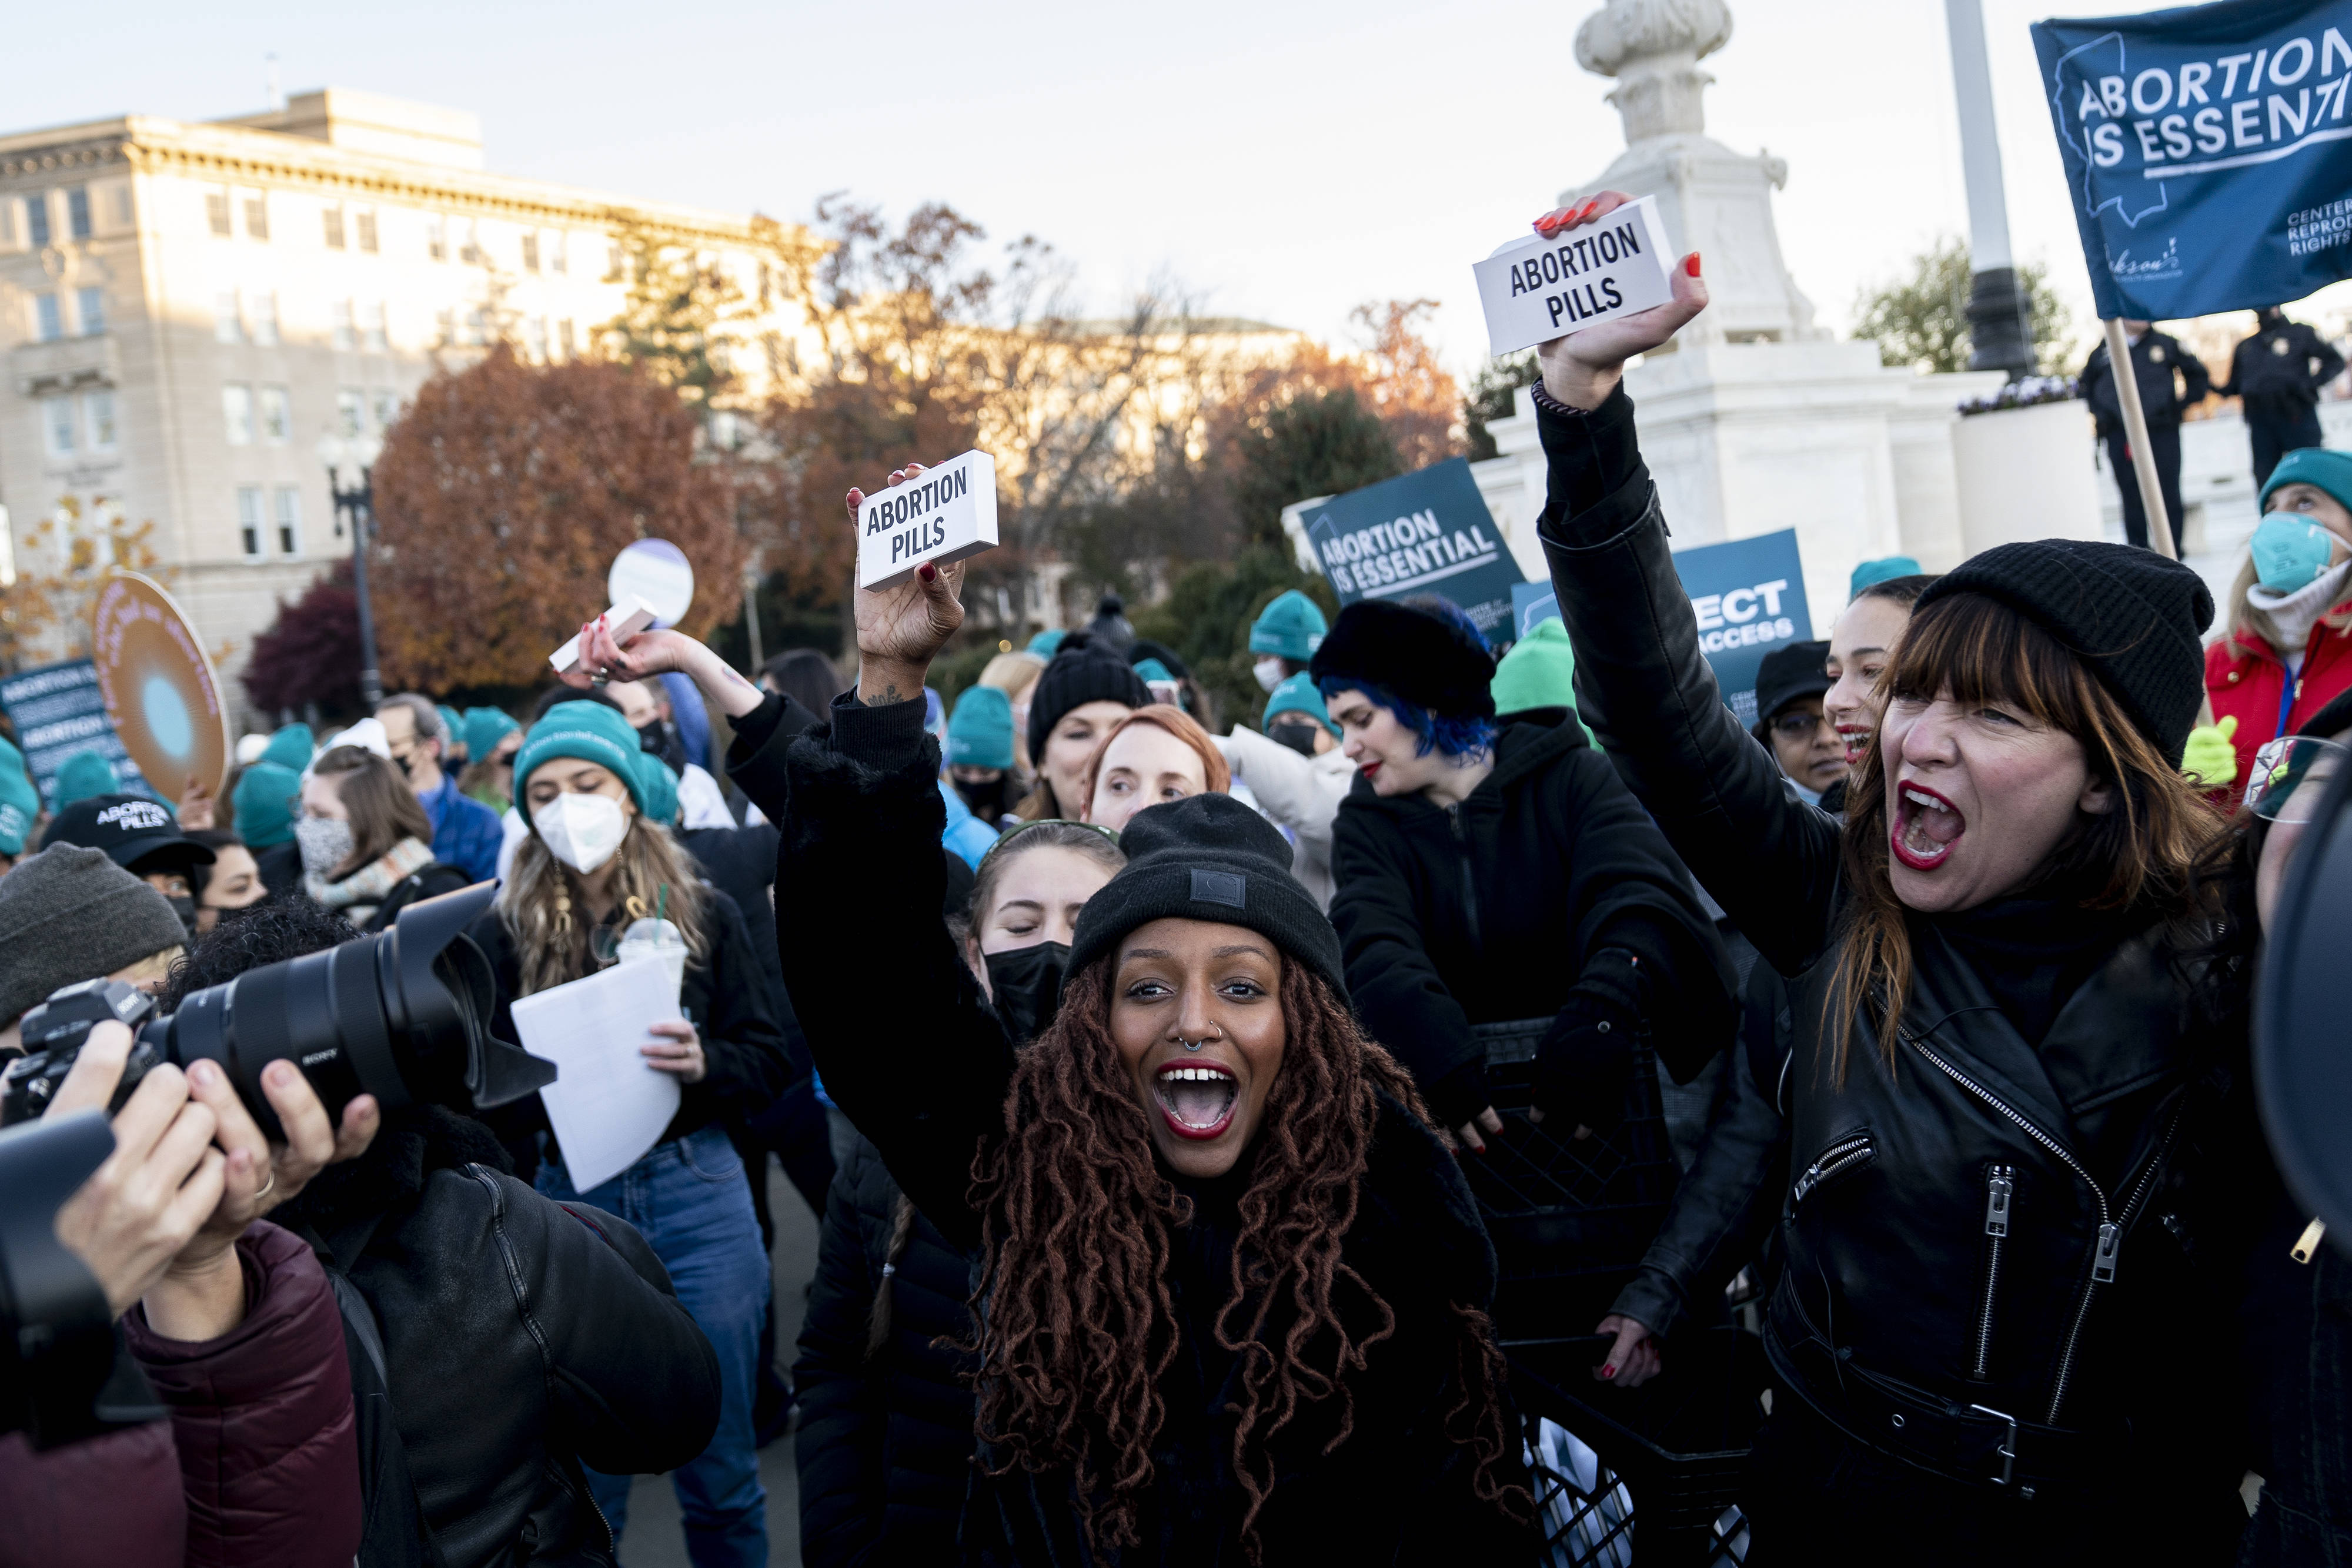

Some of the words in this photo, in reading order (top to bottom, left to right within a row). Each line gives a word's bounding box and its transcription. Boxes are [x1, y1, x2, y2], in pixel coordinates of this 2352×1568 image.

[2079, 27, 2352, 121] ABORTION
[2083, 122, 2124, 168] IS
[2134, 71, 2352, 162] ESSENTI
[1510, 222, 1641, 298] ABORTION
[2290, 229, 2351, 256] RIGHTS
[1545, 277, 1623, 328] PILLS
[867, 466, 967, 537] ABORTION
[892, 516, 946, 564] PILLS
[1321, 507, 1442, 569] ABORTION
[1330, 566, 1353, 594] IS
[1351, 524, 1496, 589] ESSENTIAL
